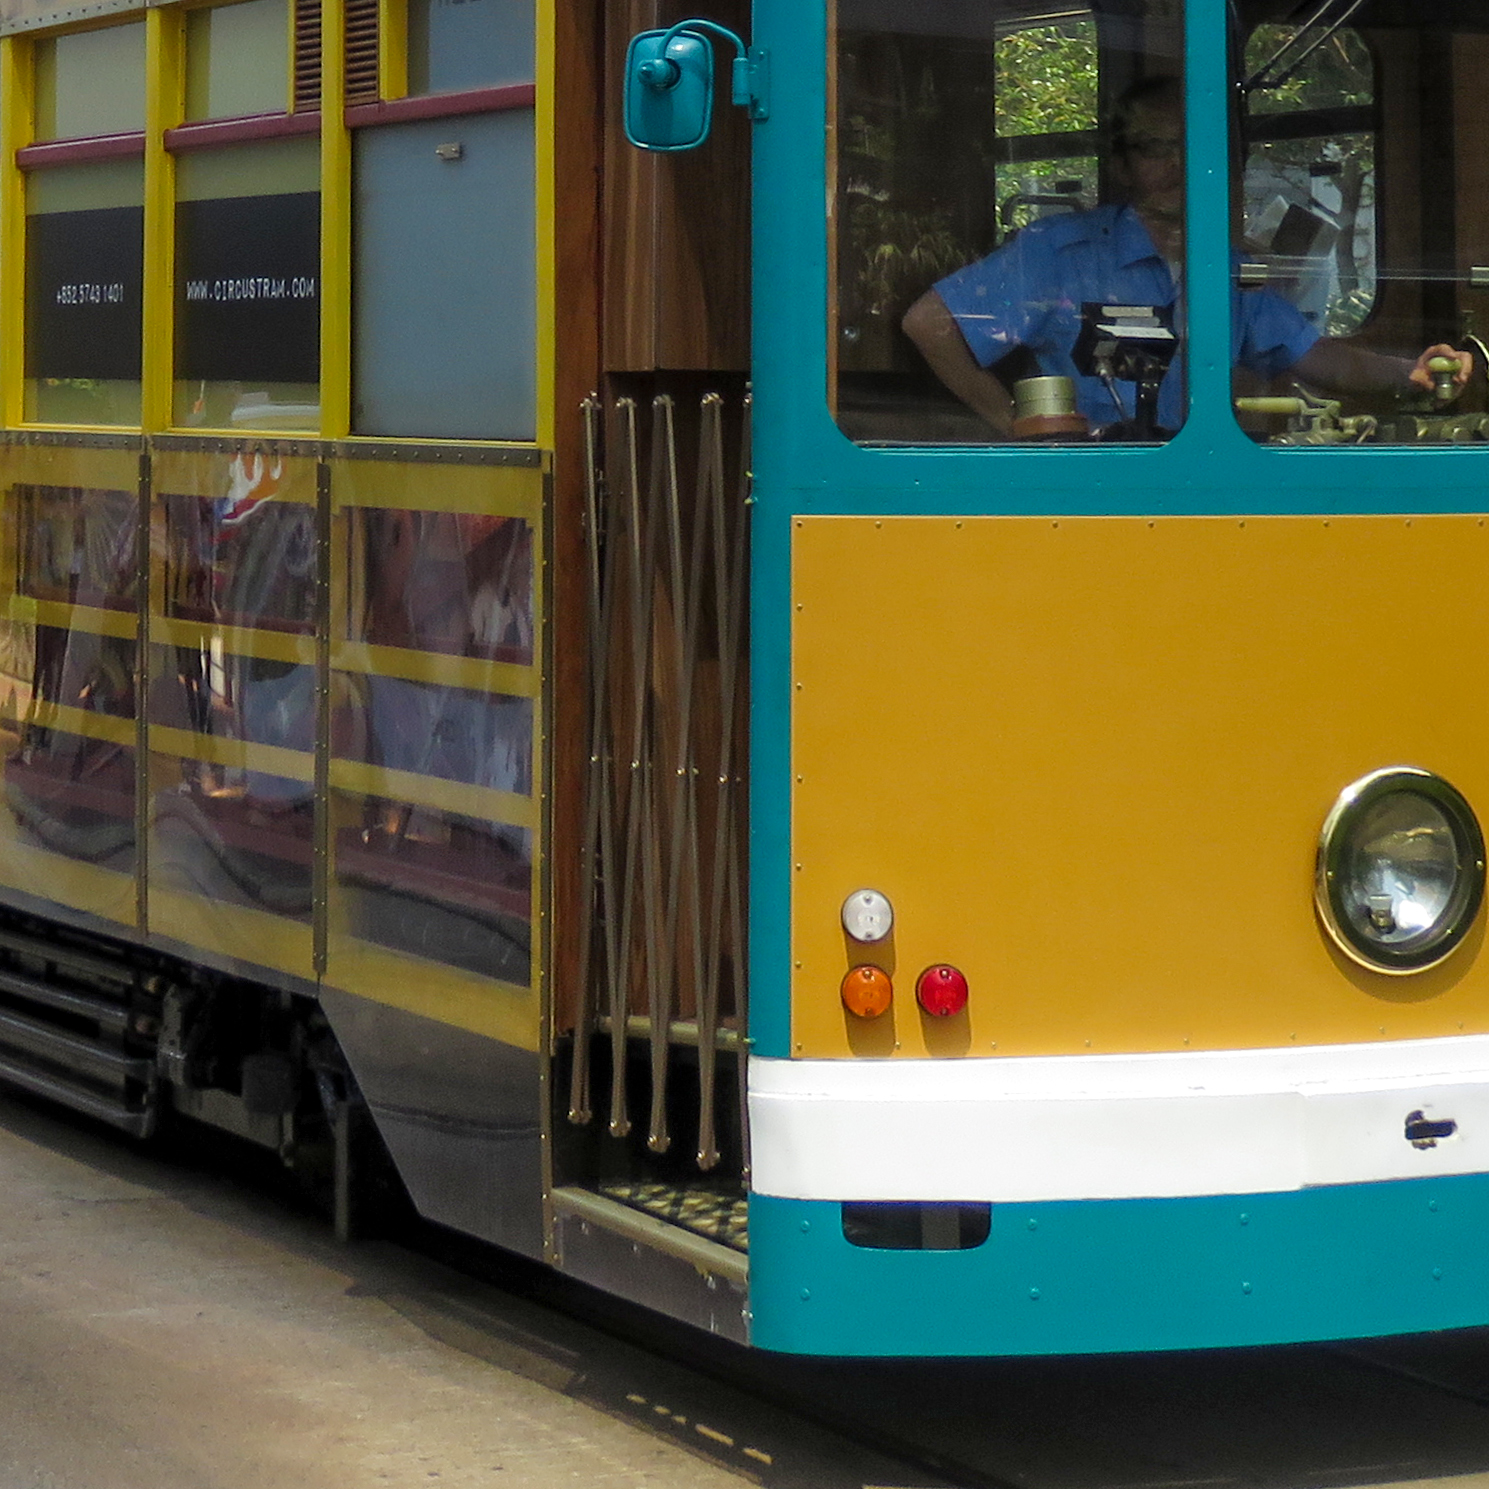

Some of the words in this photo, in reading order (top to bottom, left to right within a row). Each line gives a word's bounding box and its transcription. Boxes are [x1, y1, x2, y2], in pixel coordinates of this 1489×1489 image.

[56, 284, 77, 304] +852
[102, 282, 124, 302] 1401
[186, 277, 315, 302] WWW.CIRCUSTRAM.COM
